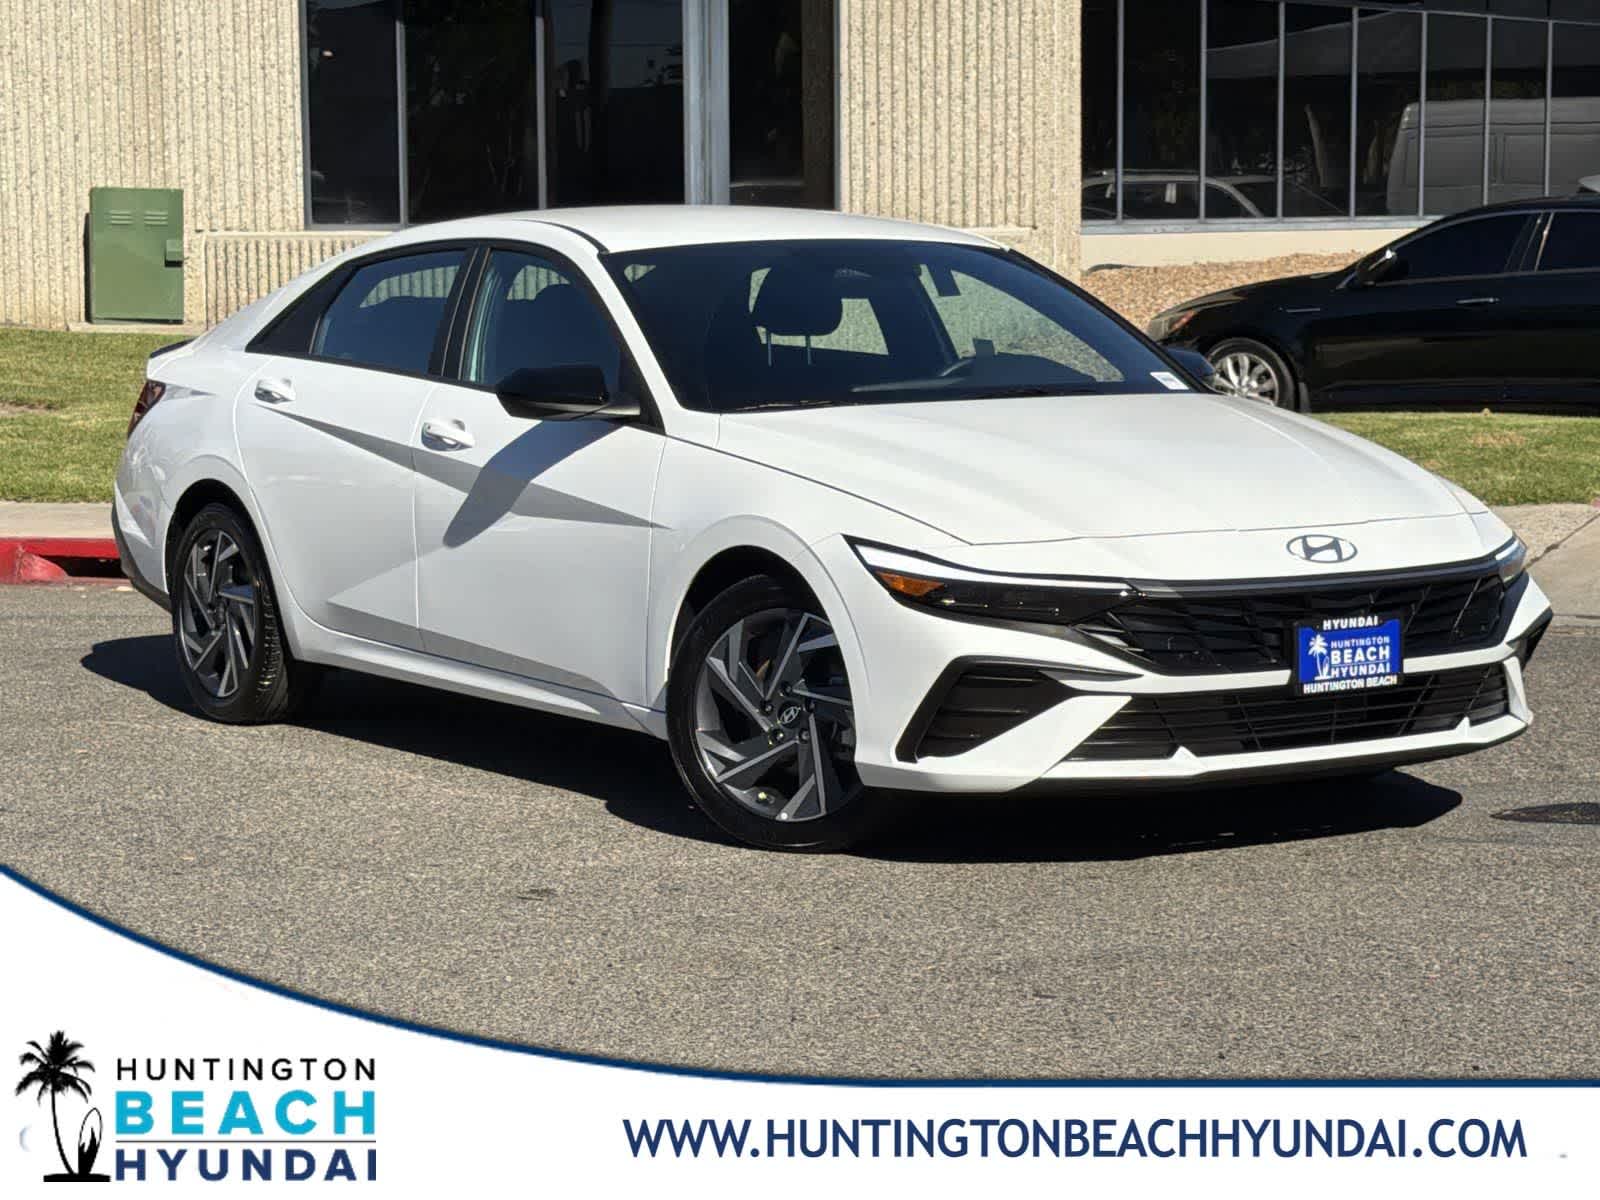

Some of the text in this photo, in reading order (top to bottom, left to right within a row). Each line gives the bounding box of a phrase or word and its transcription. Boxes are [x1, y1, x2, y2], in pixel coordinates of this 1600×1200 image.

[1323, 615, 1378, 631] HYUNDAI
[1331, 636, 1390, 649] HUNTINGTON
[1331, 645, 1390, 665] BEACH
[1331, 662, 1390, 678] HYUNDAI
[1303, 675, 1397, 694] HUNTINGTON BEACH
